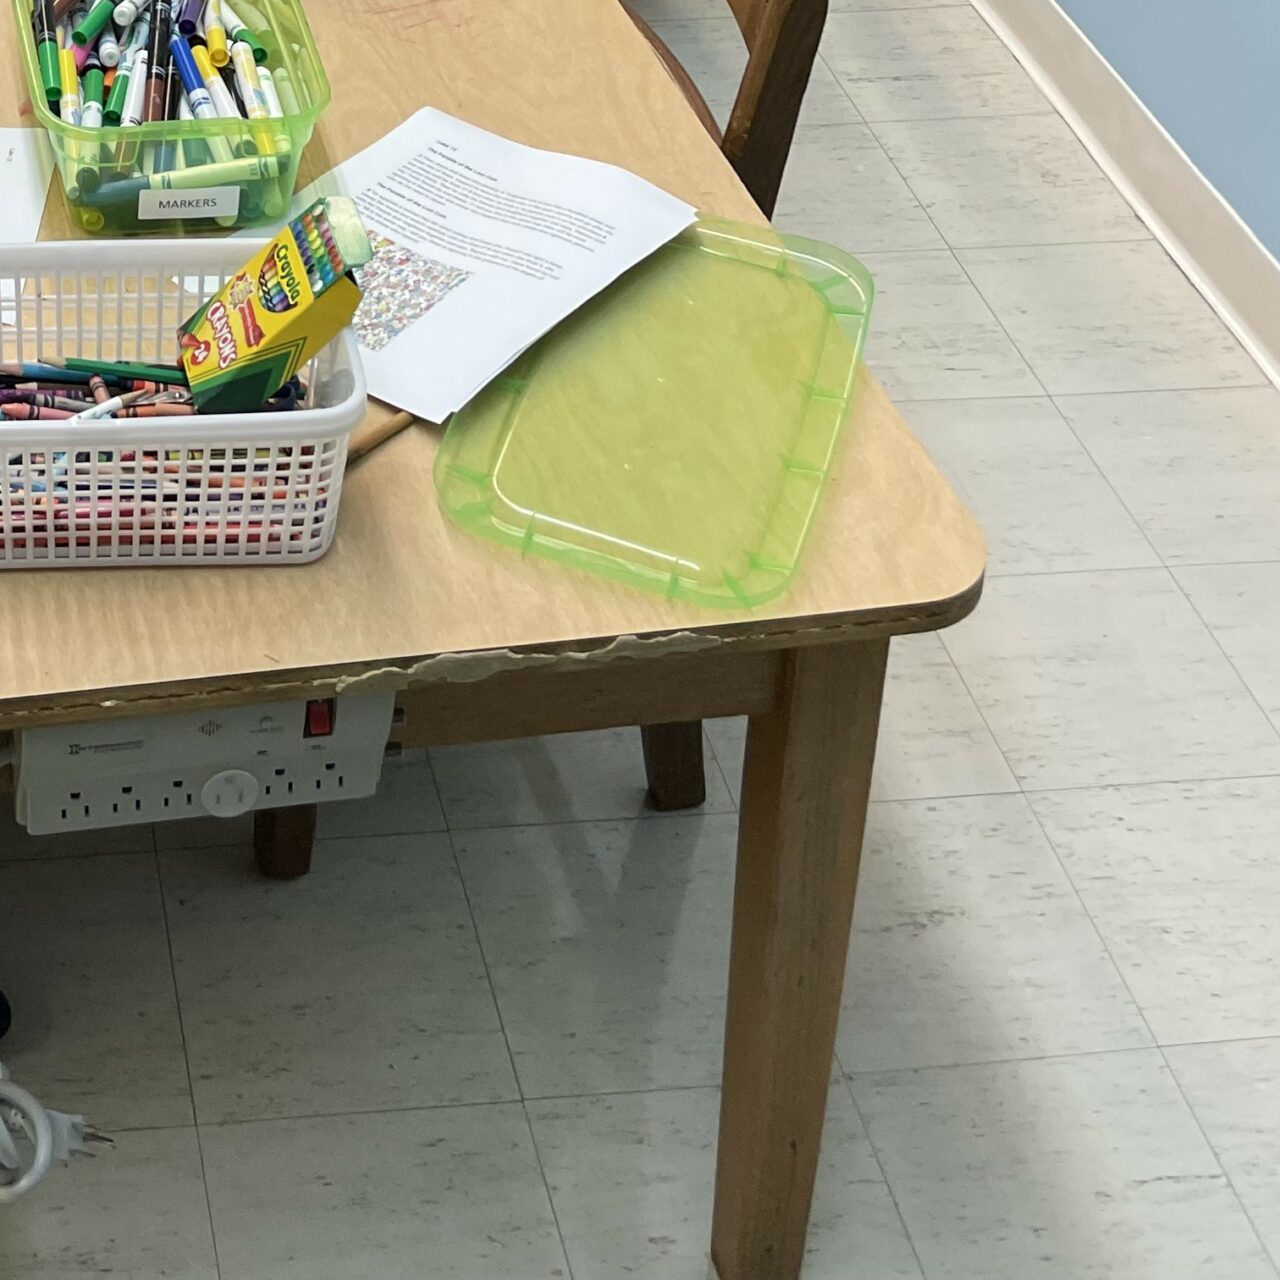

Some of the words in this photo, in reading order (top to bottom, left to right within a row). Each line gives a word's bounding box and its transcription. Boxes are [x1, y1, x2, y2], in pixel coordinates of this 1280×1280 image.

[157, 197, 218, 210] MARKERS
[275, 243, 303, 305] Crayola
[193, 342, 210, 363] 24
[207, 301, 237, 369] CRAYONS
